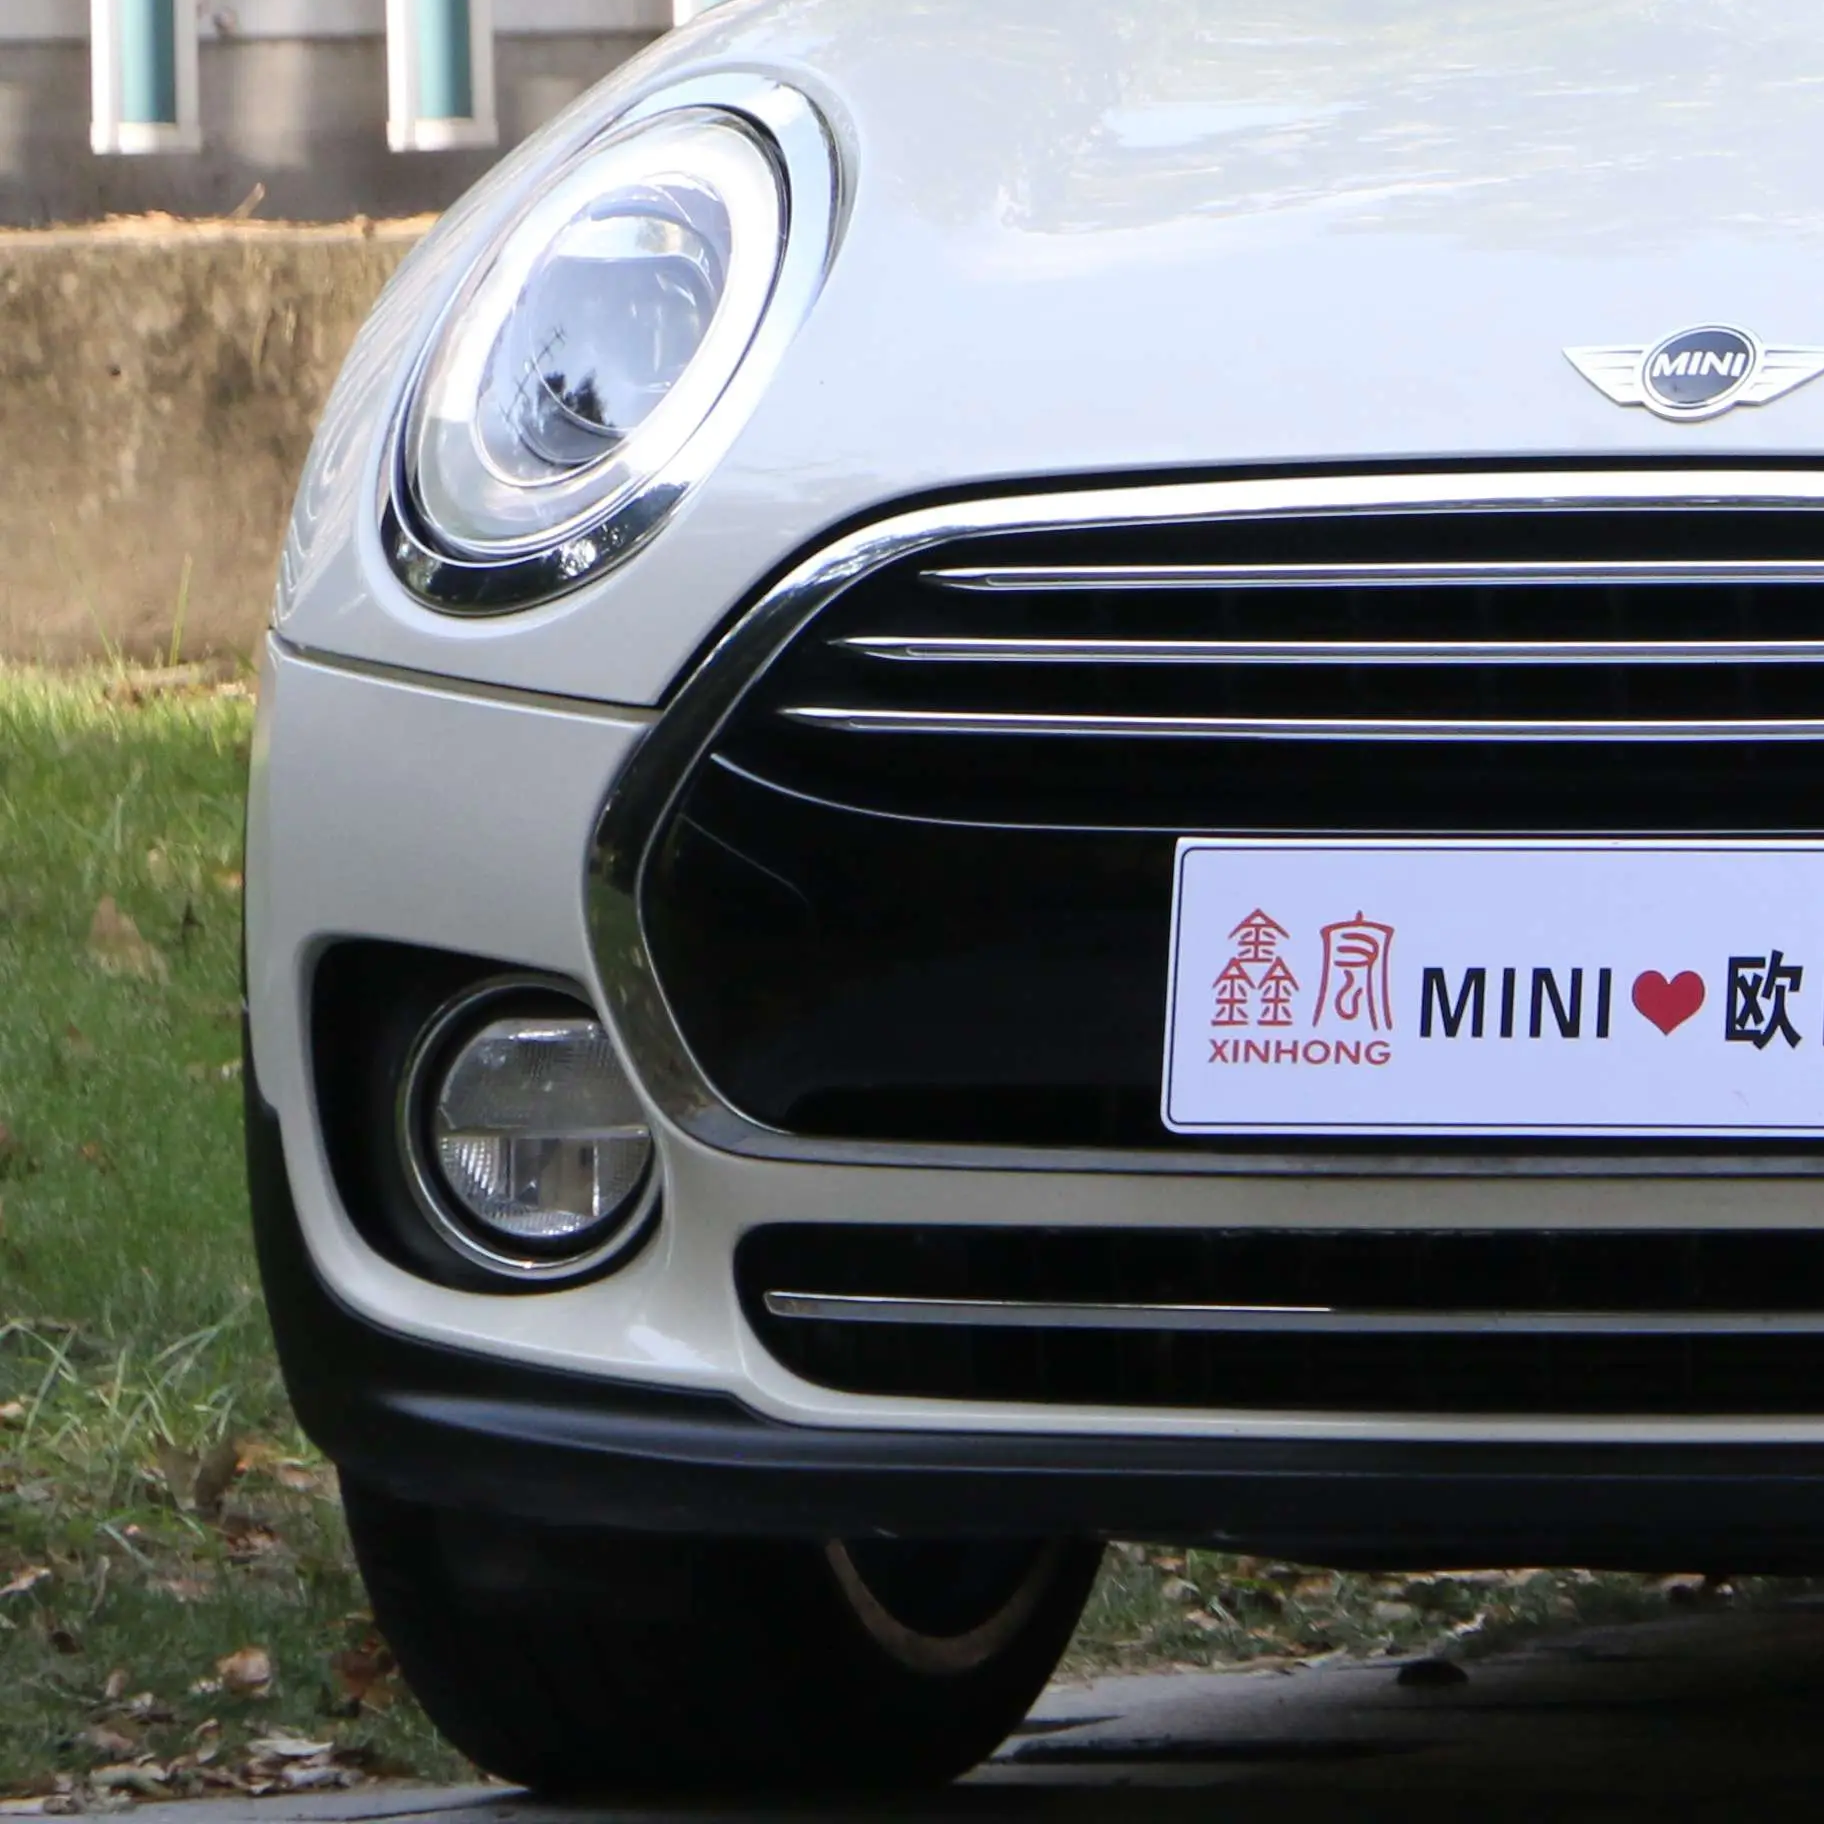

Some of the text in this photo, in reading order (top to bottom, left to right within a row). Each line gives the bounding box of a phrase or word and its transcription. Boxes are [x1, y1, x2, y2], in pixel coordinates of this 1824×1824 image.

[1652, 351, 1746, 377] MINI
[1420, 967, 1612, 1038] MINI
[1208, 1038, 1392, 1066] XINHONG
